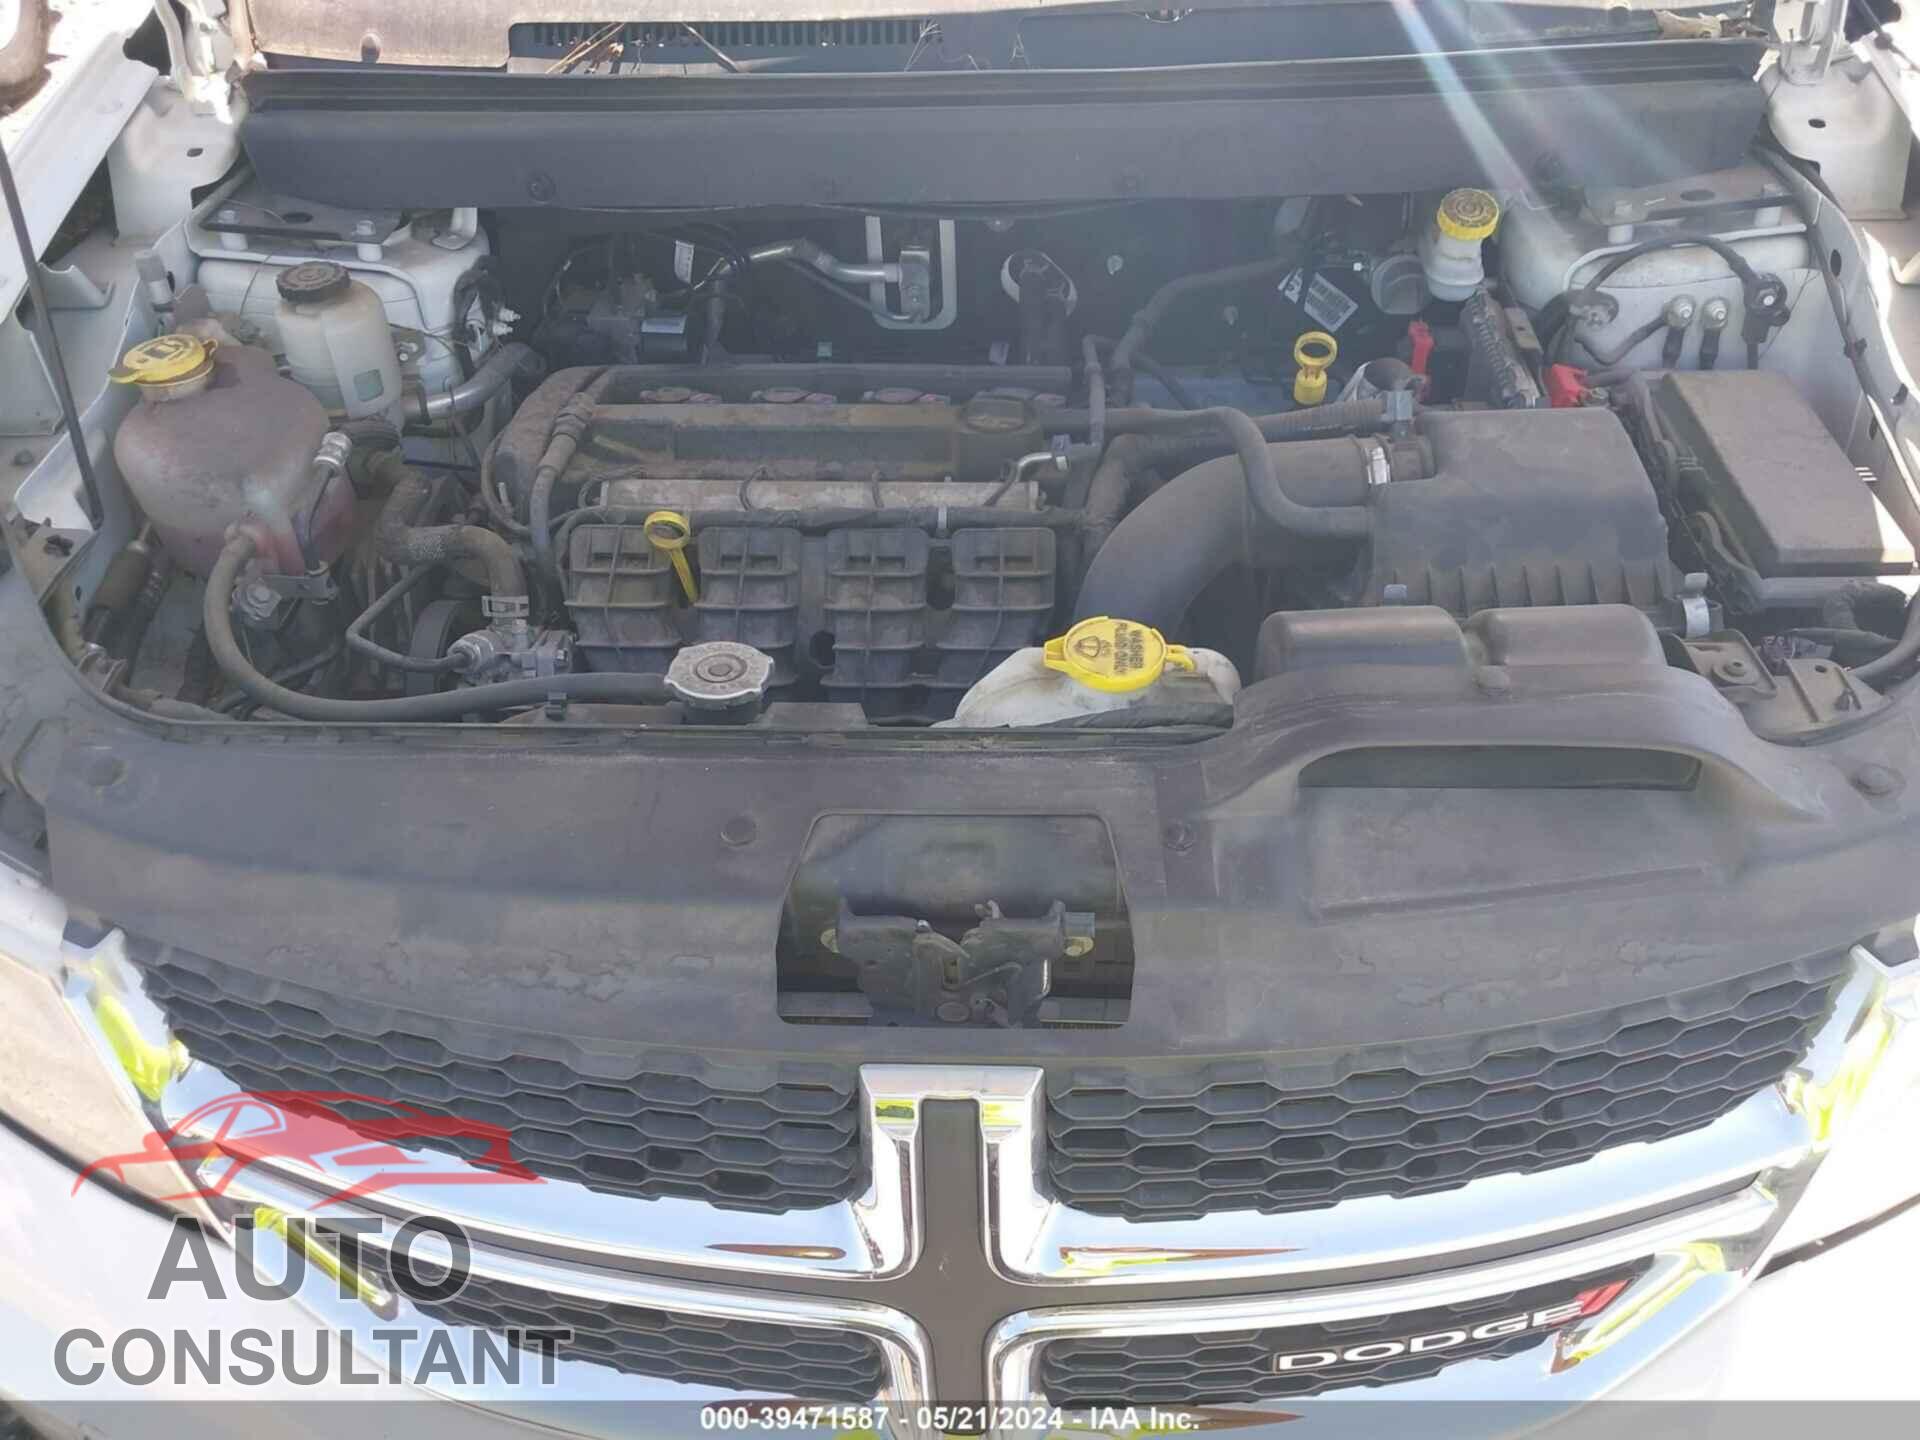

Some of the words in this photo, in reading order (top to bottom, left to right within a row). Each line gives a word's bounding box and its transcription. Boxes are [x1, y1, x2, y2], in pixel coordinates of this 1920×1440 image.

[1114, 623, 1128, 649] FLUID
[1129, 629, 1144, 669] WASHER
[1114, 651, 1128, 676] ONLY
[1278, 1300, 1584, 1371] DODGE
